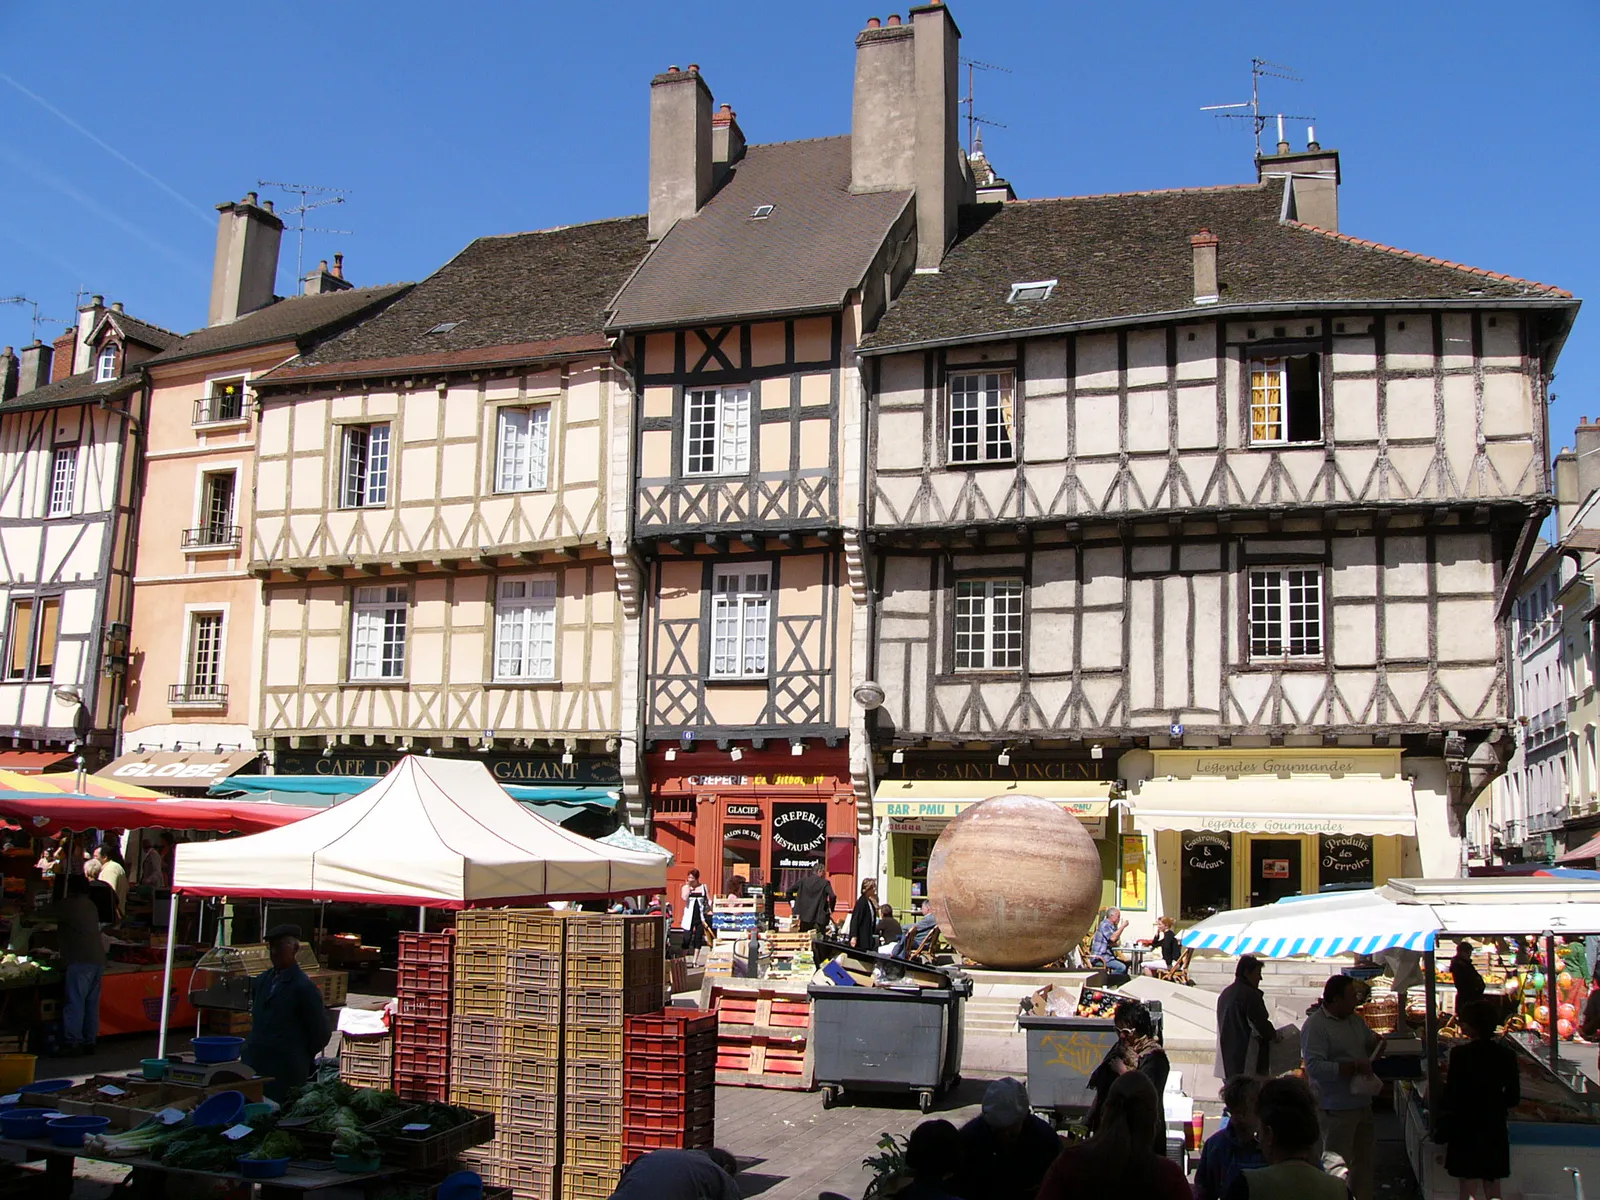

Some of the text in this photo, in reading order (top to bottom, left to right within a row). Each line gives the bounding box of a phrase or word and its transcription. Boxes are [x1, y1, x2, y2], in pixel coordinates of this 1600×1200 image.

[685, 731, 692, 739] 6
[113, 762, 231, 778] GLOBE
[315, 758, 365, 775] CAFE
[493, 761, 579, 779] GALANT
[901, 763, 1105, 780] Le SAINT VINCENT
[1195, 757, 1353, 774] Légendes Gourmandes
[687, 774, 748, 786] CREPERIE
[728, 805, 759, 815] GLACIER
[887, 803, 910, 815] BAR
[919, 803, 945, 815] PMU
[1072, 803, 1092, 811] PMU
[773, 810, 826, 830] CREPERIE
[1201, 817, 1344, 832] Légendes Gourmandes
[723, 828, 742, 840] SALON
[742, 828, 750, 836] DE
[772, 832, 826, 853] RESTAURANT
[1183, 835, 1231, 851] Gastronomie
[1324, 836, 1370, 853] Produits
[1203, 846, 1212, 856] &
[1338, 848, 1353, 857] des
[1189, 856, 1225, 870] Cadeaux
[1322, 855, 1370, 871] Terroirs
